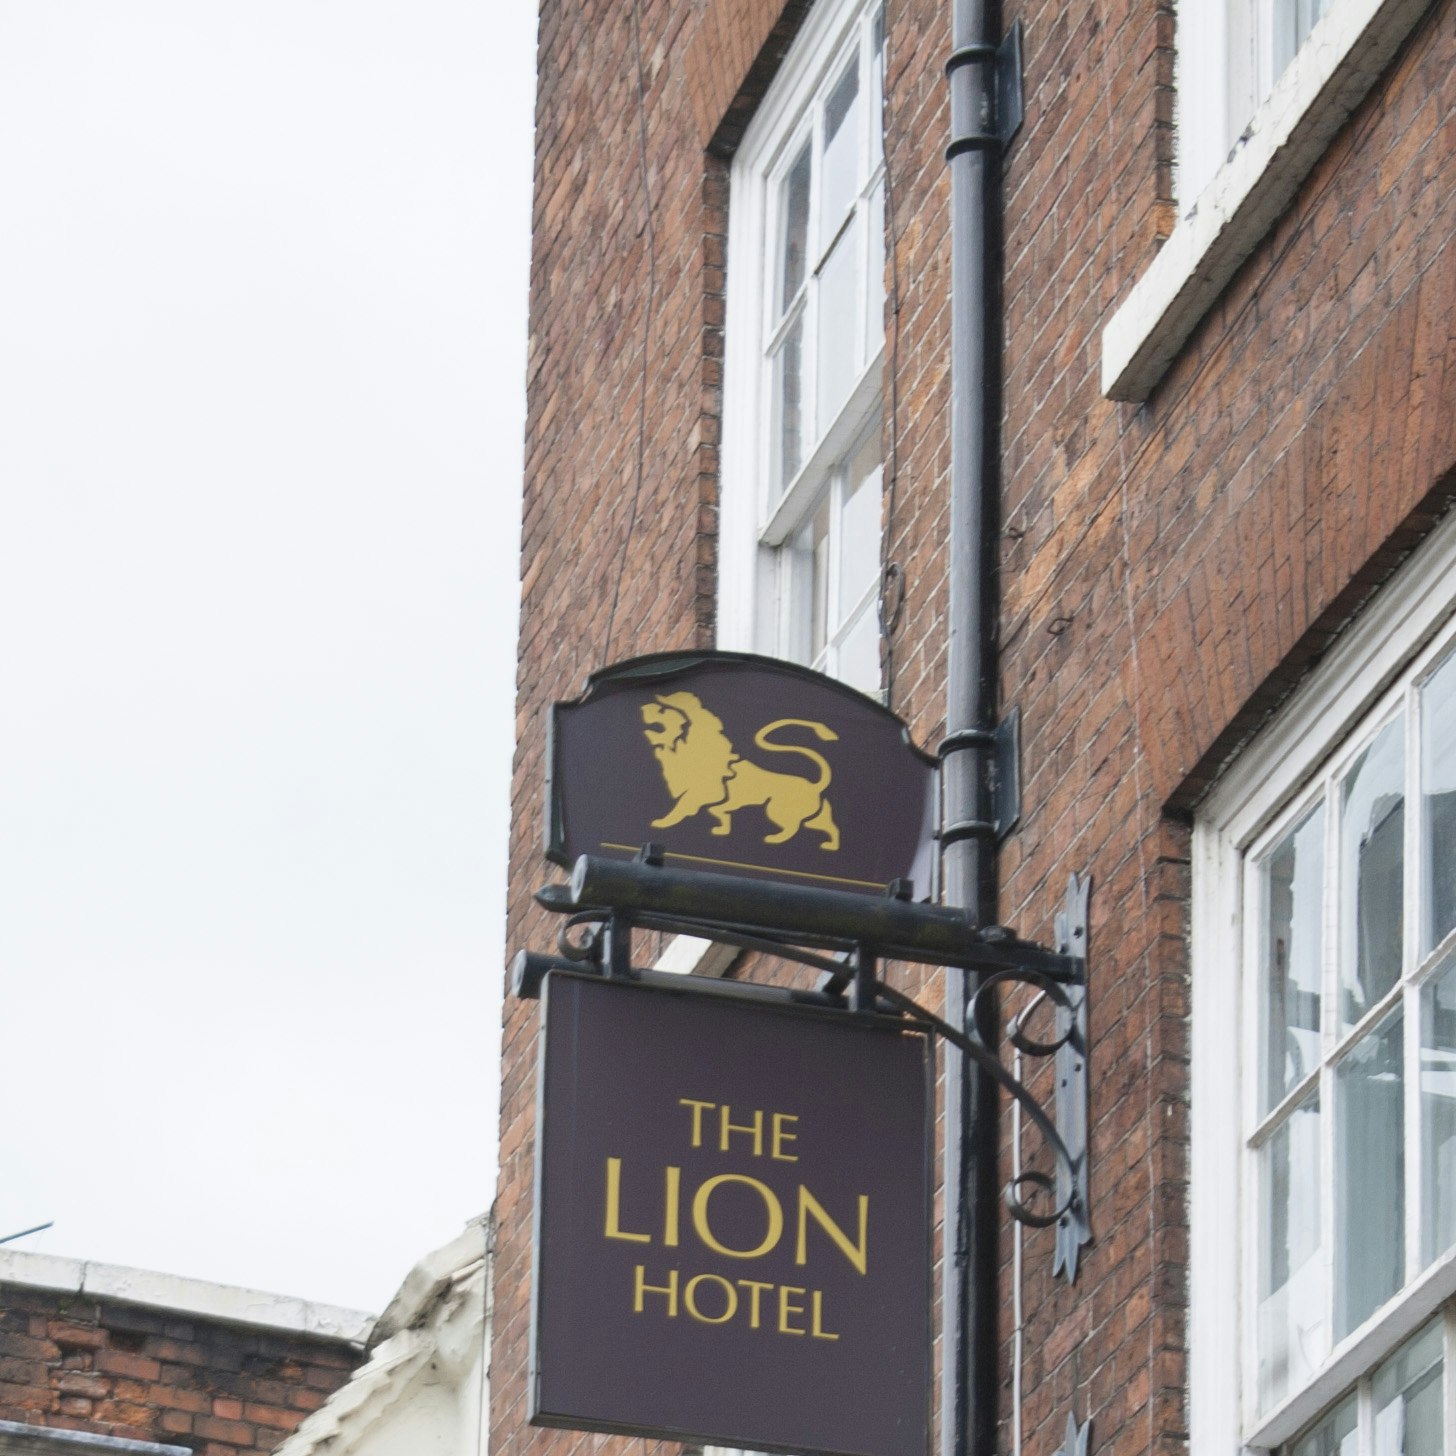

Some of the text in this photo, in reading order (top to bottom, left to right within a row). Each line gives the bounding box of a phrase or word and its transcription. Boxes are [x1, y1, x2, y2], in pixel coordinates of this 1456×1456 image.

[679, 1098, 800, 1162] THE
[604, 1157, 869, 1276] LION
[633, 1264, 840, 1340] HOTEL
